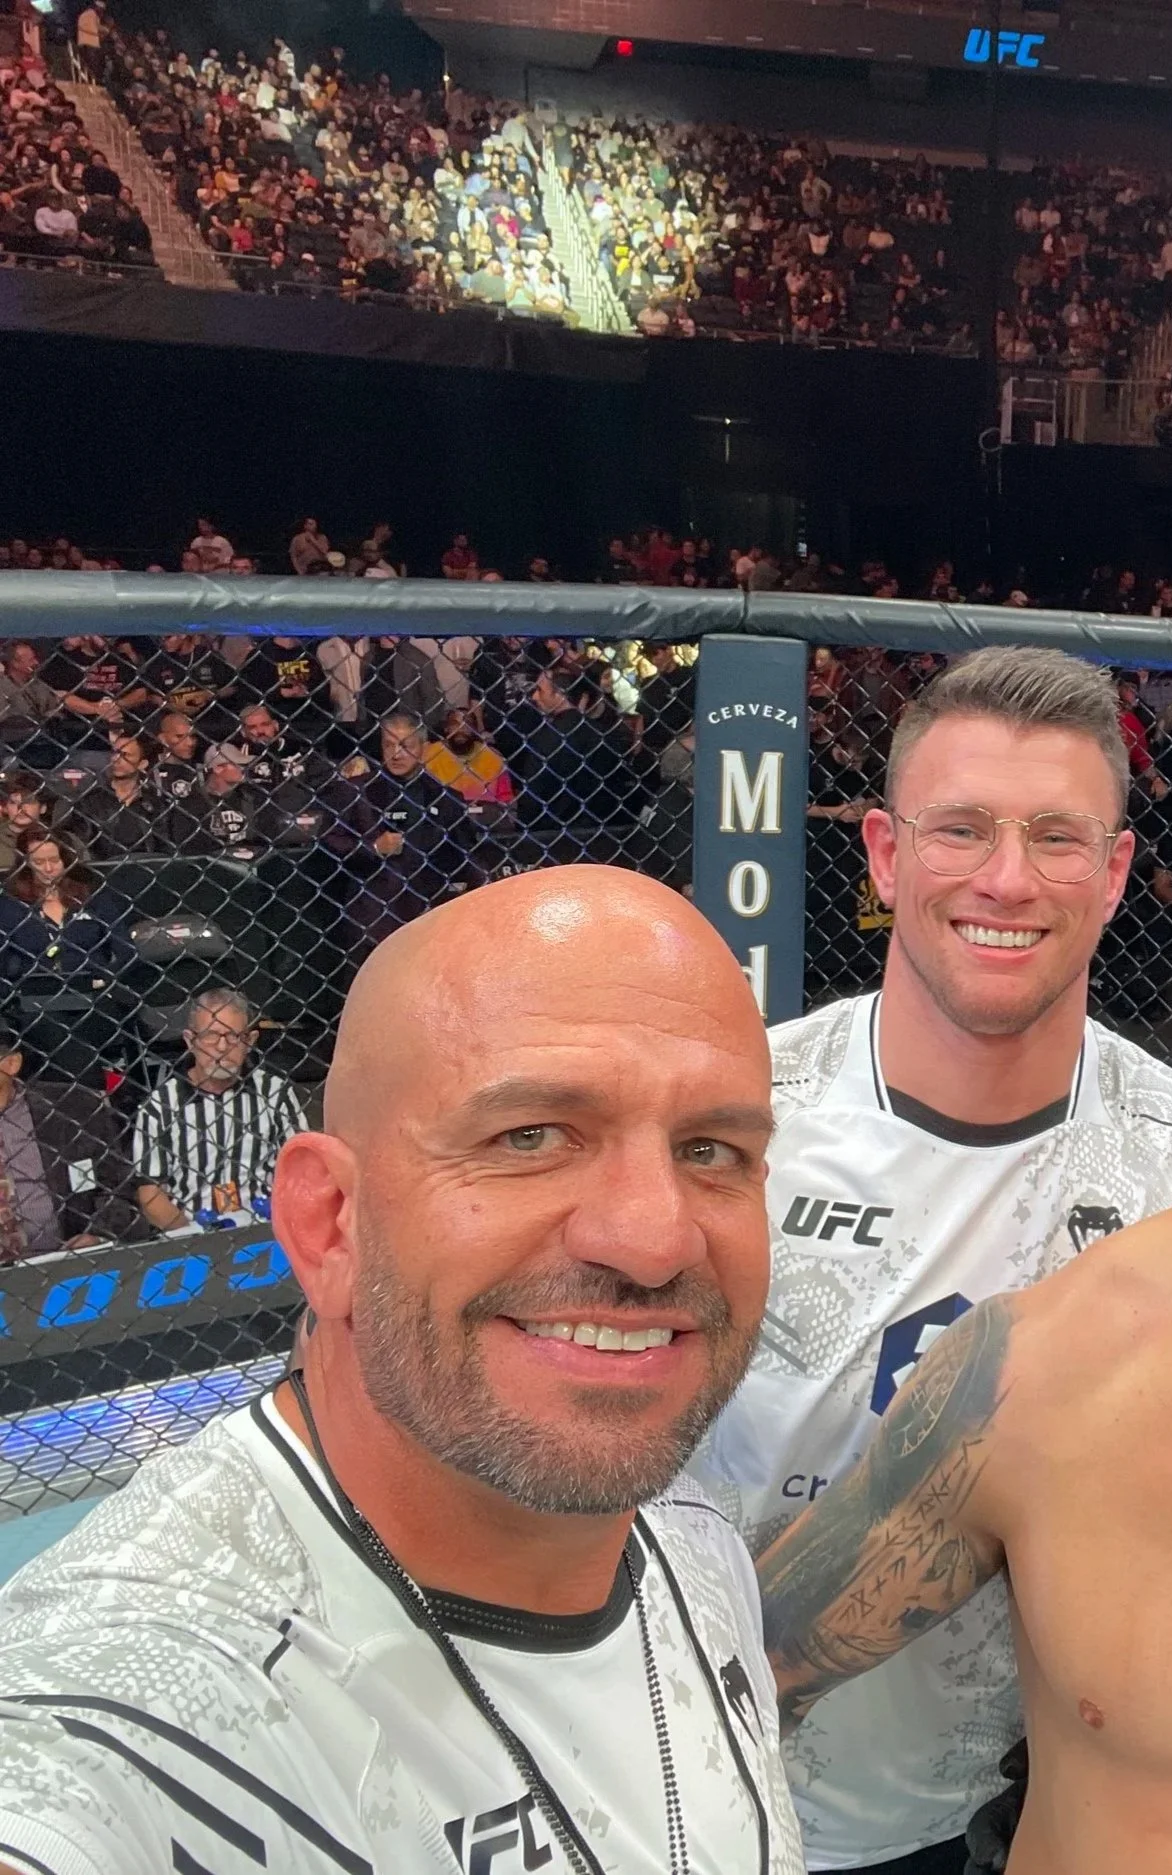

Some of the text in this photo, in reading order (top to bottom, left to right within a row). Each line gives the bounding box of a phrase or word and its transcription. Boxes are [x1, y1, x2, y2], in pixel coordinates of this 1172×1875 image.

[963, 28, 1046, 68] UFC
[707, 703, 800, 730] CERVEZA
[781, 1195, 894, 1247] UFC
